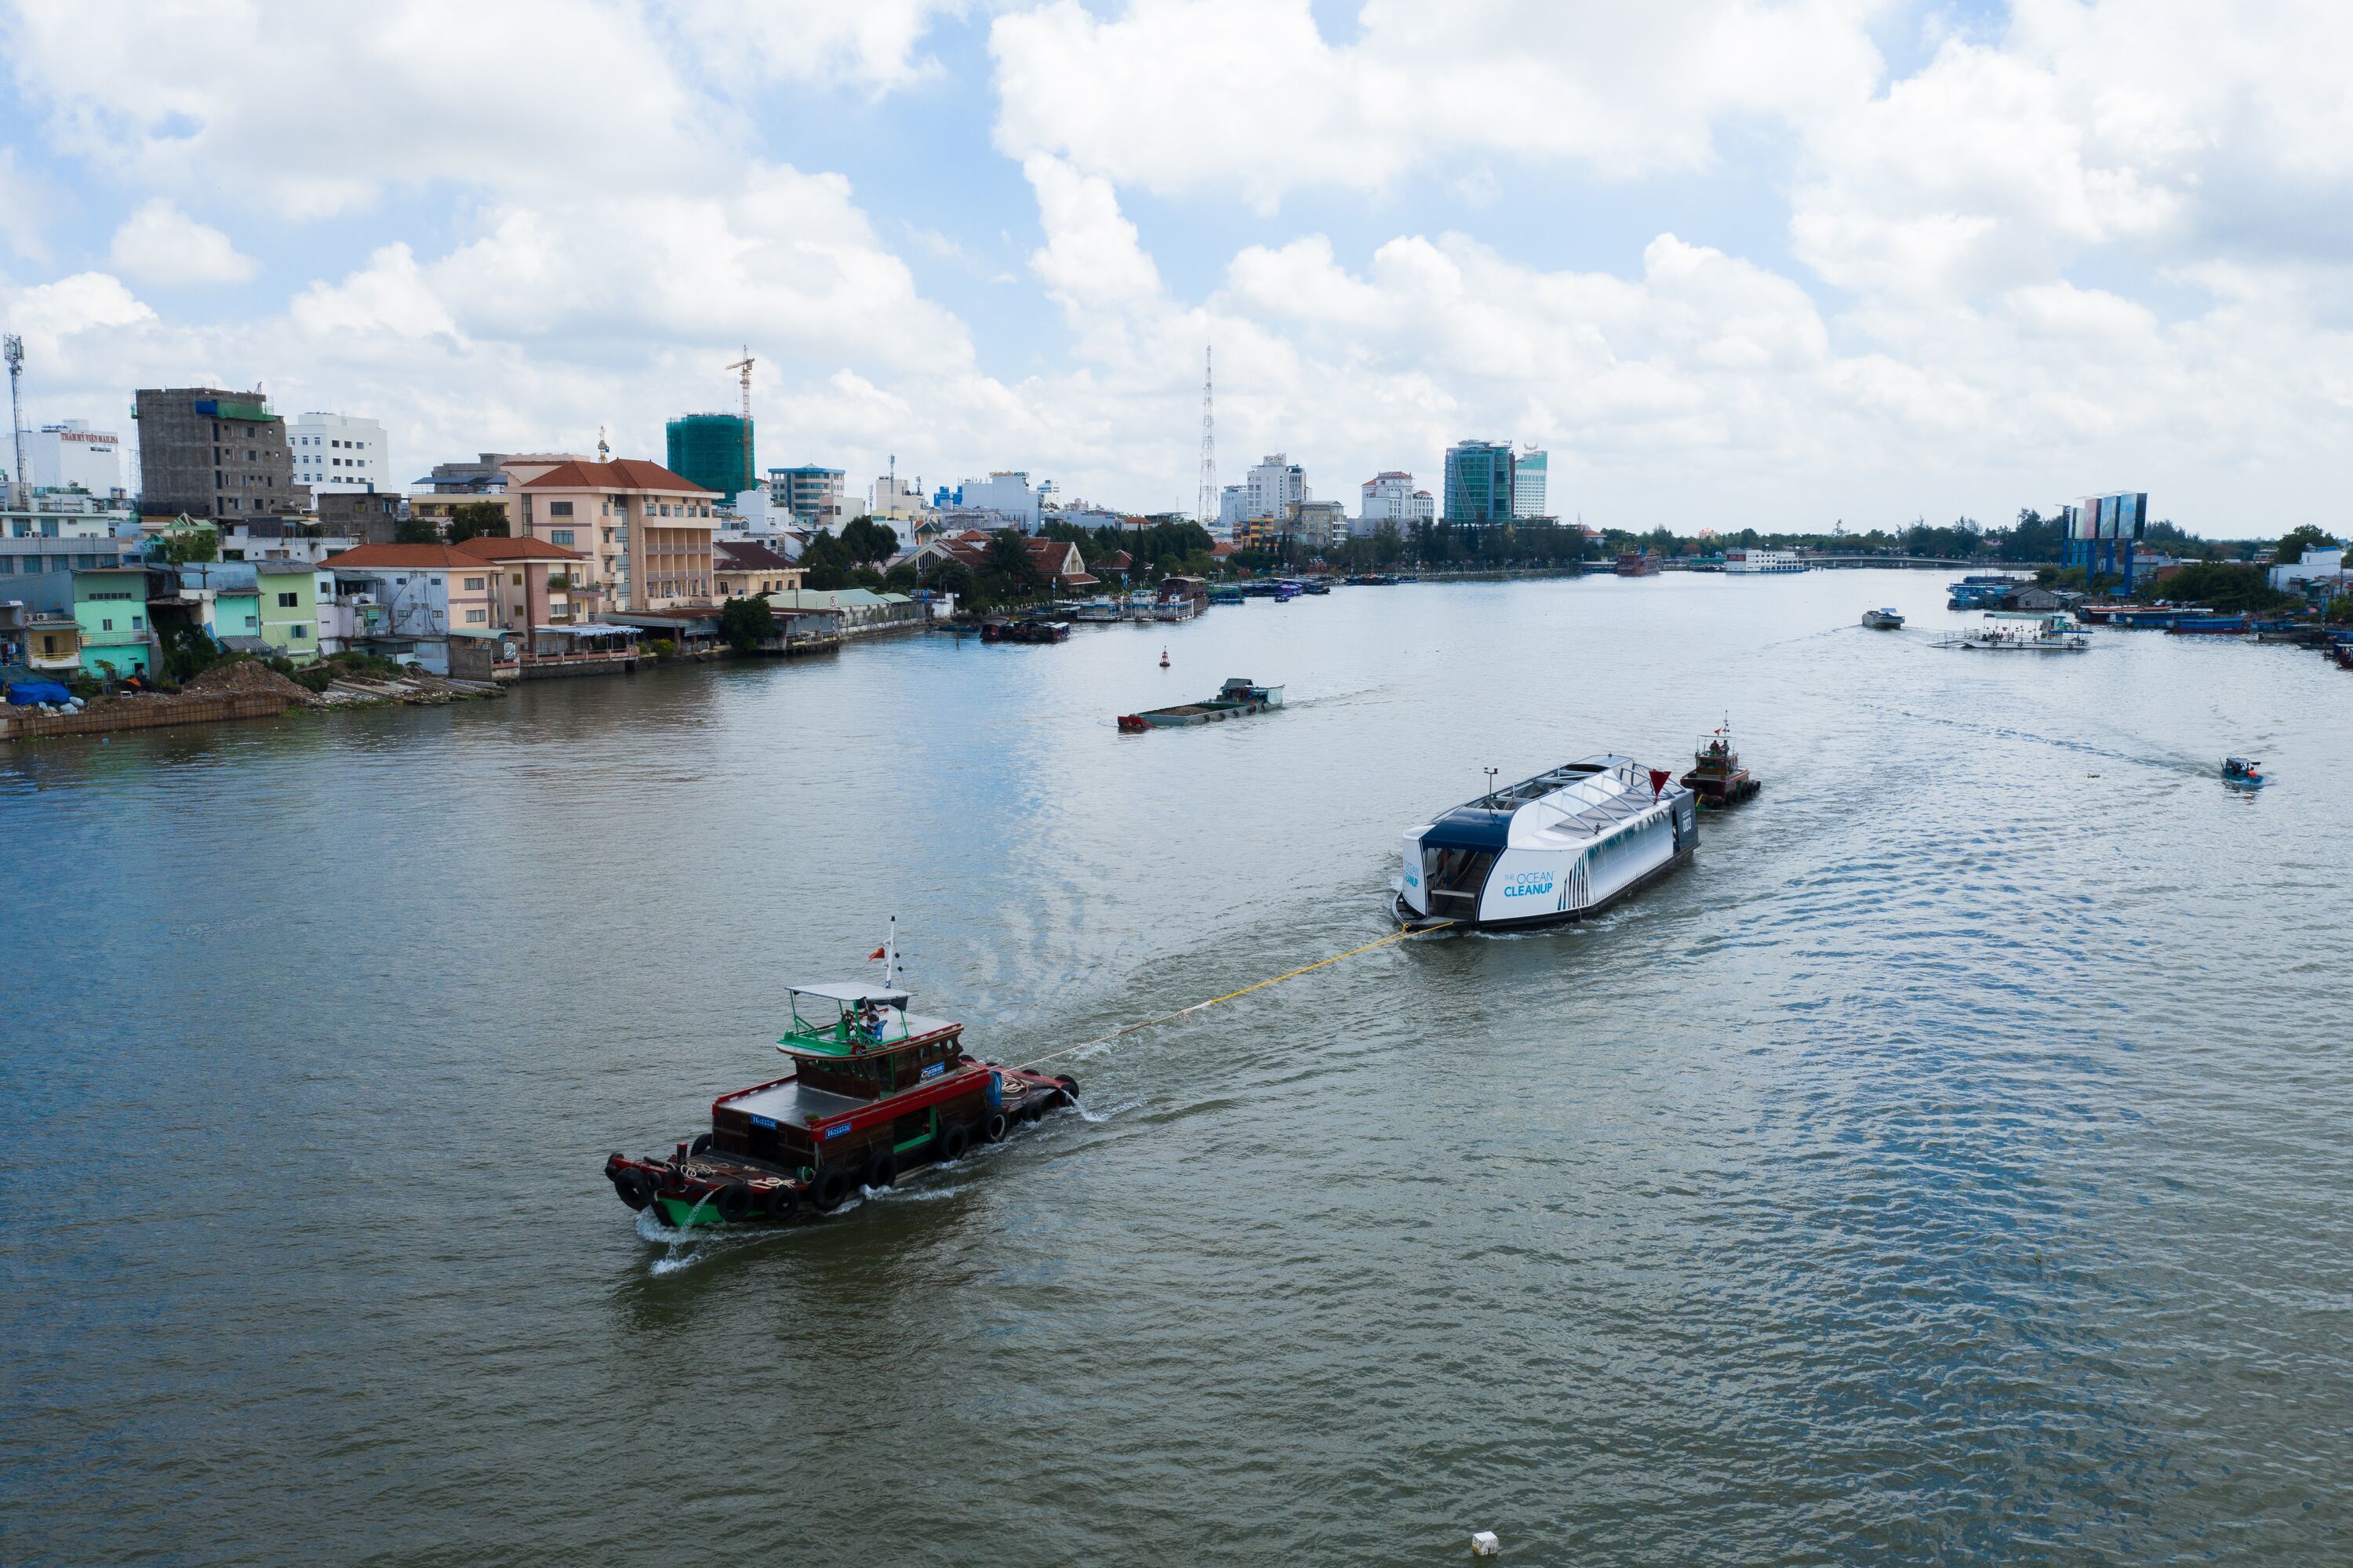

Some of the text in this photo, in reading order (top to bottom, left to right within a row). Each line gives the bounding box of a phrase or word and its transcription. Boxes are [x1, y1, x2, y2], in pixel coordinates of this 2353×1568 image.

[1683, 817, 1692, 833] 003
[1517, 871, 1553, 884] OCEAN
[1504, 882, 1552, 897] CLEANUP
